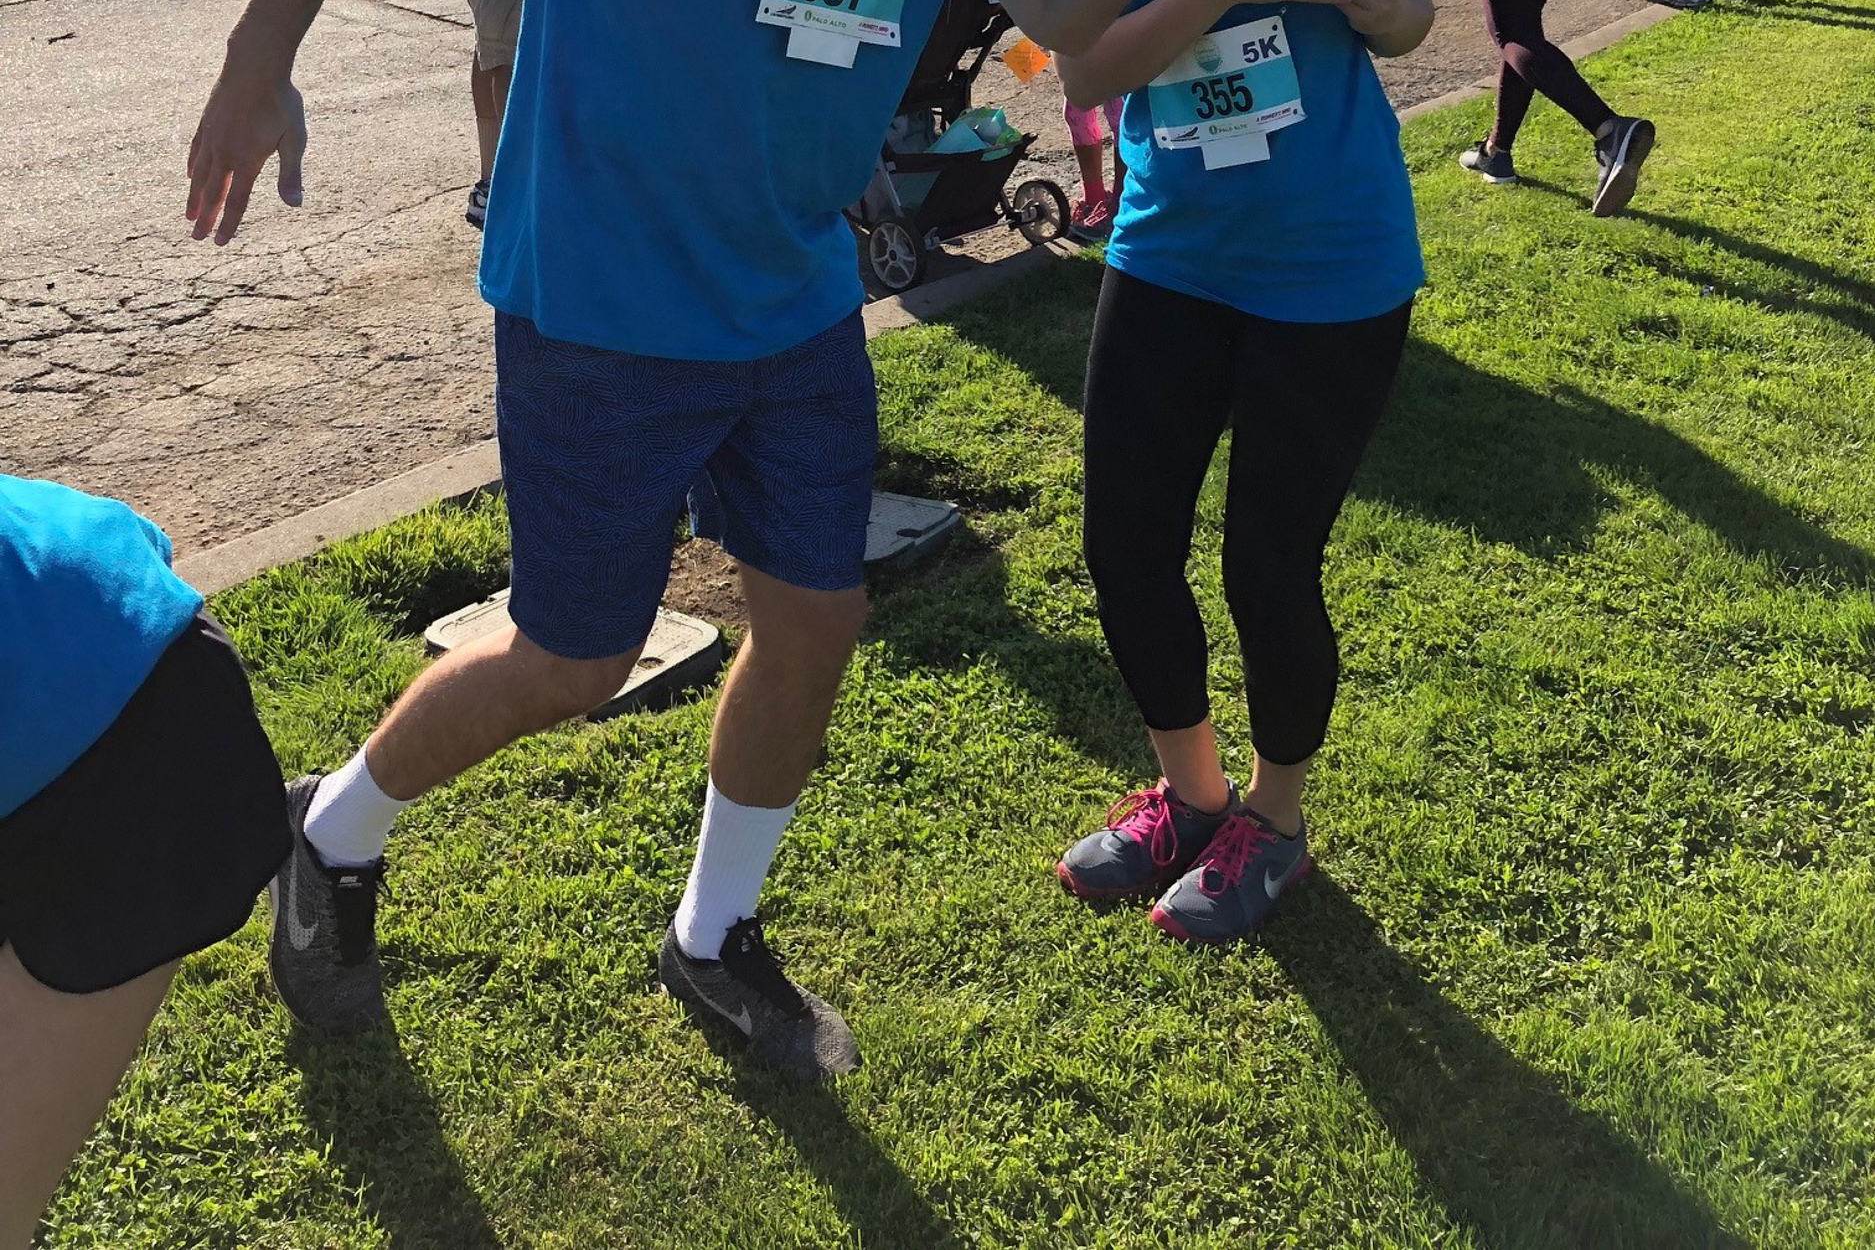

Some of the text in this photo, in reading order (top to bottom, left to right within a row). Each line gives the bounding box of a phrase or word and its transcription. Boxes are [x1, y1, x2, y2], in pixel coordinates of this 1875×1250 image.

[812, 16, 828, 25] PALO
[829, 19, 847, 29] ALTO
[1242, 34, 1283, 63] 5K
[1190, 72, 1254, 120] 355
